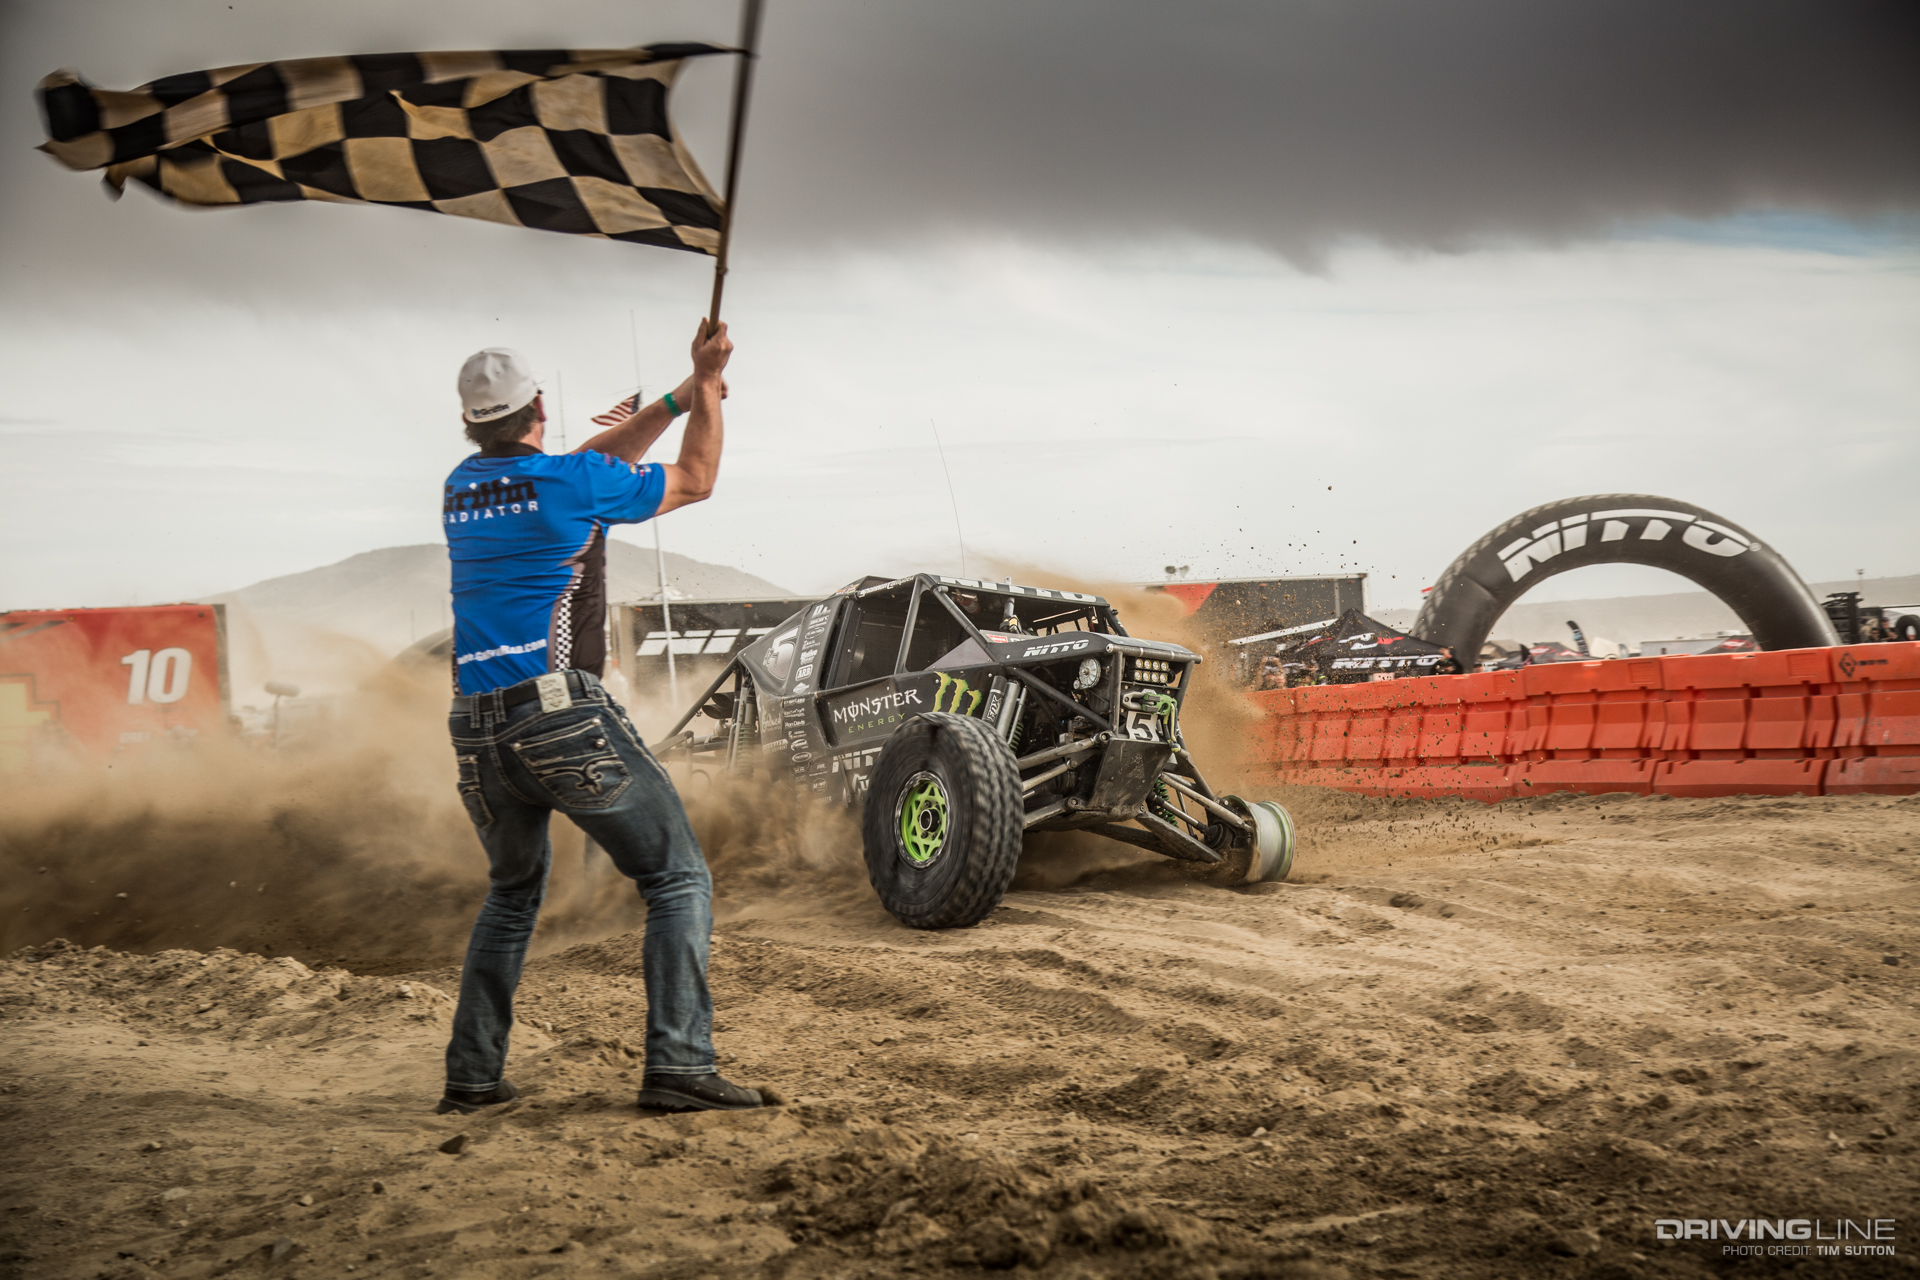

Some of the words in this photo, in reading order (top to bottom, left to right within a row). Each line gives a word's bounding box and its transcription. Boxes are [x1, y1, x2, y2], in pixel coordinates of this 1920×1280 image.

[444, 479, 539, 513] Griffin
[1497, 509, 1752, 583] NITTO
[1023, 639, 1090, 657] NITTO
[1331, 655, 1443, 670] NITTO
[121, 647, 192, 705] 10
[833, 688, 923, 724] MONSTER
[848, 713, 906, 734] ENERGY
[1131, 712, 1154, 741] 5
